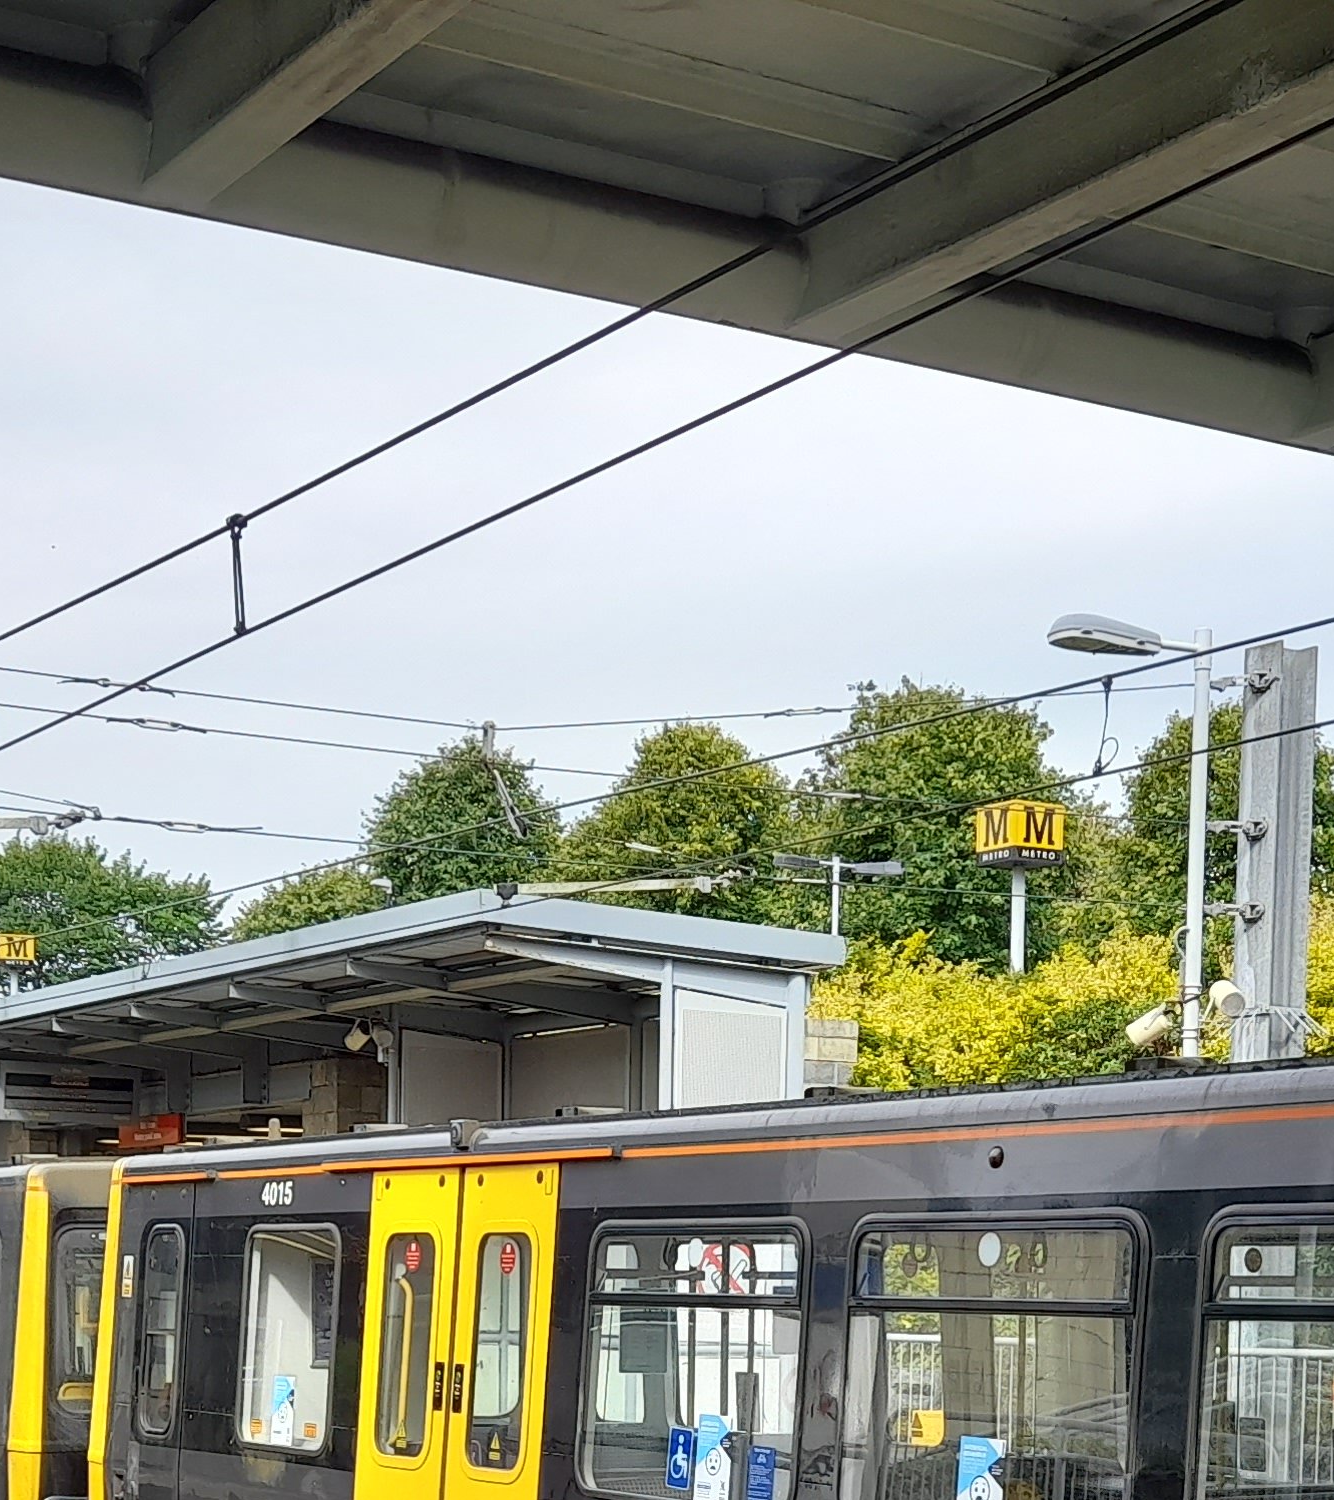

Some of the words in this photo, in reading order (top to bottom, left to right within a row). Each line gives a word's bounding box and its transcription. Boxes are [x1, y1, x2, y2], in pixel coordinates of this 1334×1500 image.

[984, 809, 1009, 847] M
[1023, 806, 1055, 845] M
[1021, 849, 1056, 860] METRO
[261, 1181, 293, 1206] 4015
